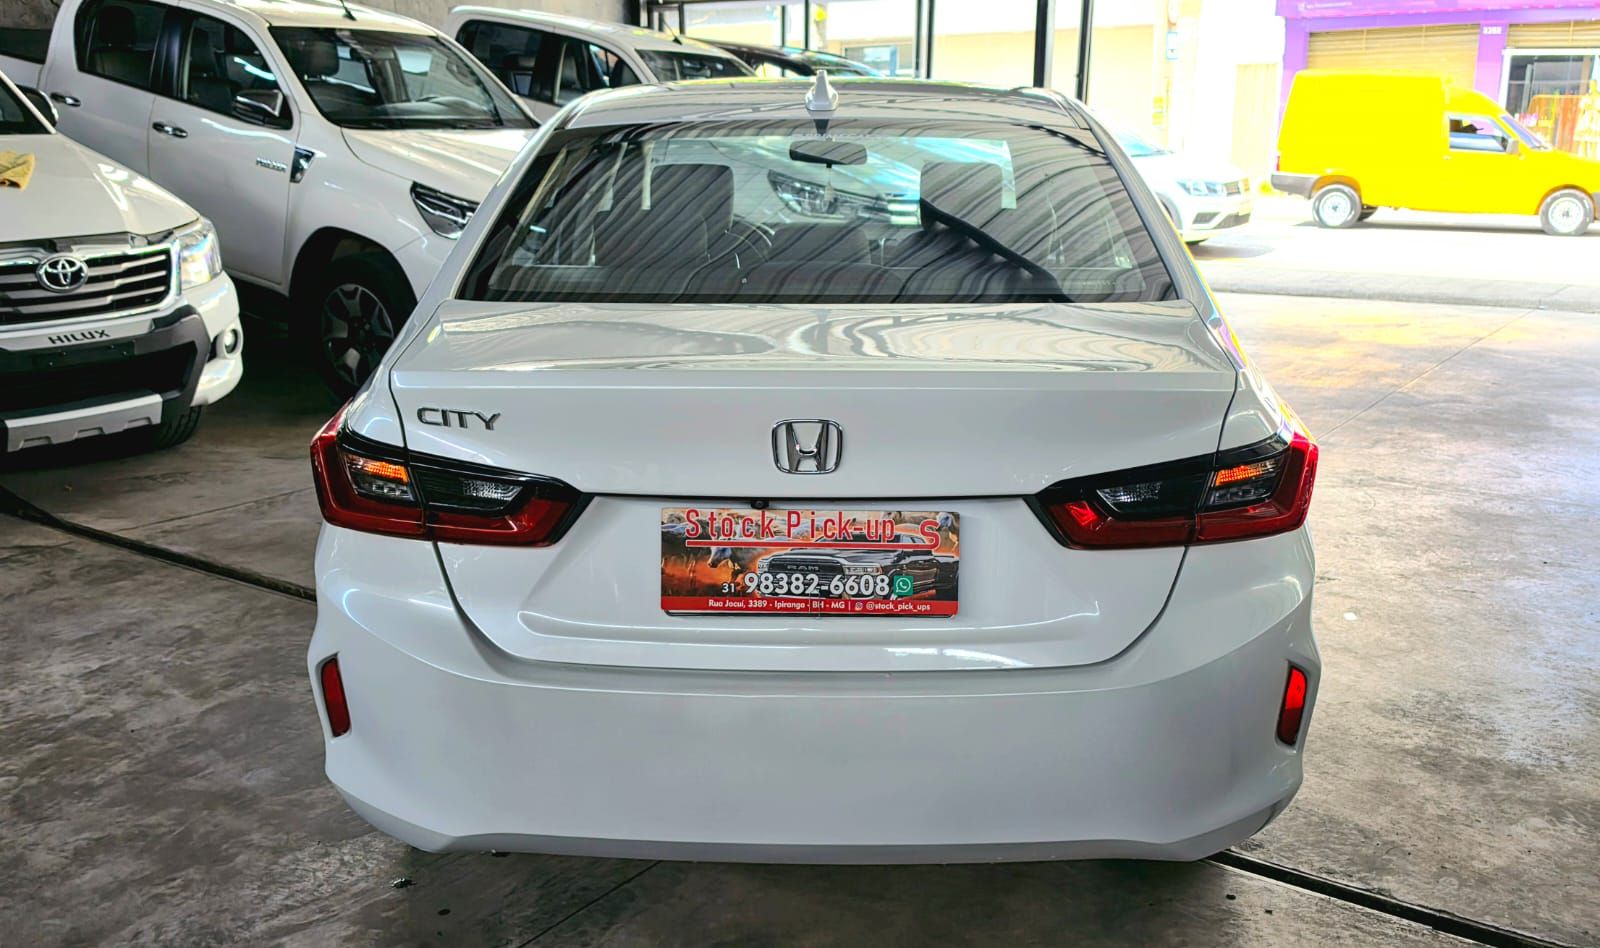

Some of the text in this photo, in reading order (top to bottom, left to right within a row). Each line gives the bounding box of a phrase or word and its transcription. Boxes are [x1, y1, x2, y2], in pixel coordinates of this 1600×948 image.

[48, 329, 110, 345] HILUX
[417, 407, 501, 431] CITY
[685, 509, 774, 538] Stock
[785, 510, 896, 543] Pick-up
[721, 573, 890, 596] 31 98382-6608
[708, 599, 723, 607] Rua
[748, 599, 768, 608] 3389
[774, 600, 806, 610] Ipiranga
[812, 601, 825, 609] BH
[831, 601, 846, 609] MG
[866, 602, 931, 612] @stock_pick_ups
